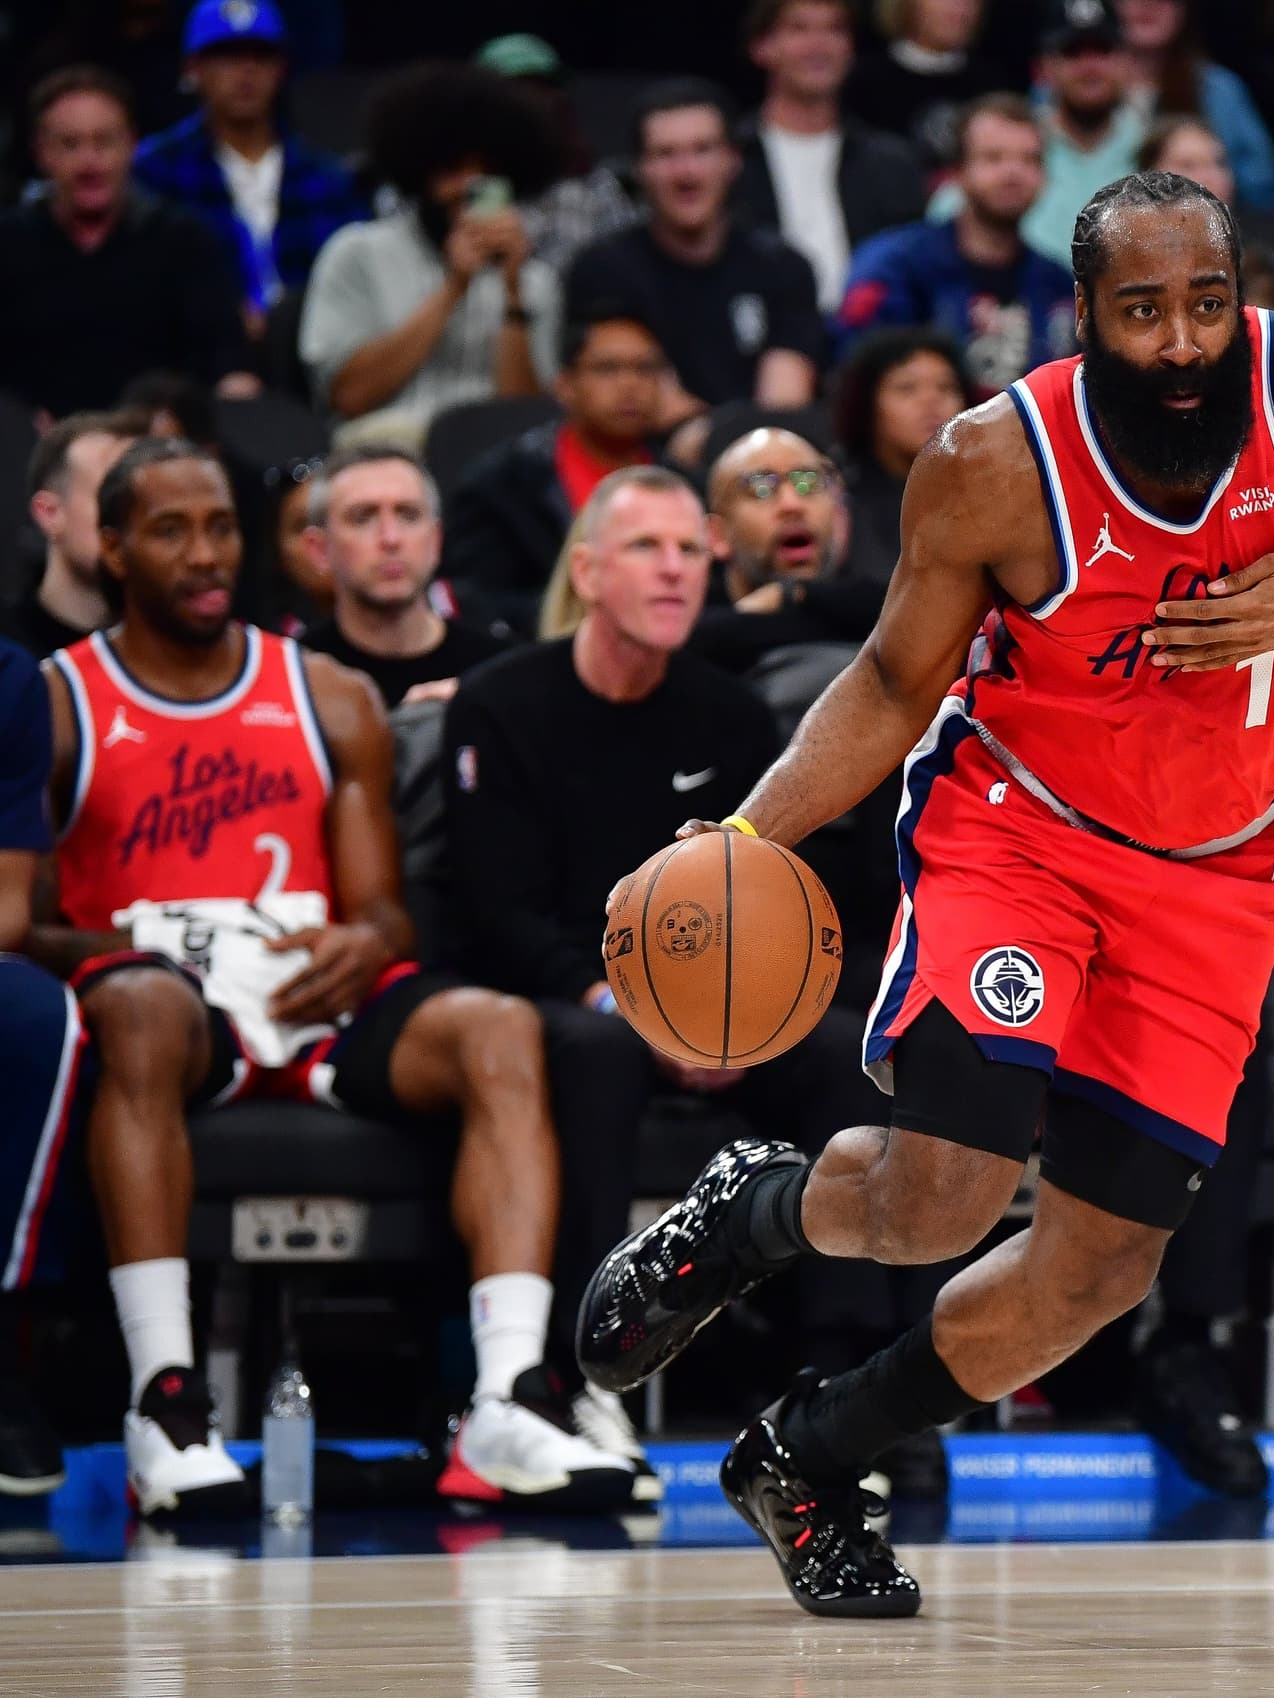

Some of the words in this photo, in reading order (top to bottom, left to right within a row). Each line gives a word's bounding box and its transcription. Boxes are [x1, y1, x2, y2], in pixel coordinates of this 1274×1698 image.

[168, 744, 242, 799] Los
[119, 760, 301, 866] Angeles
[254, 831, 292, 898] 2
